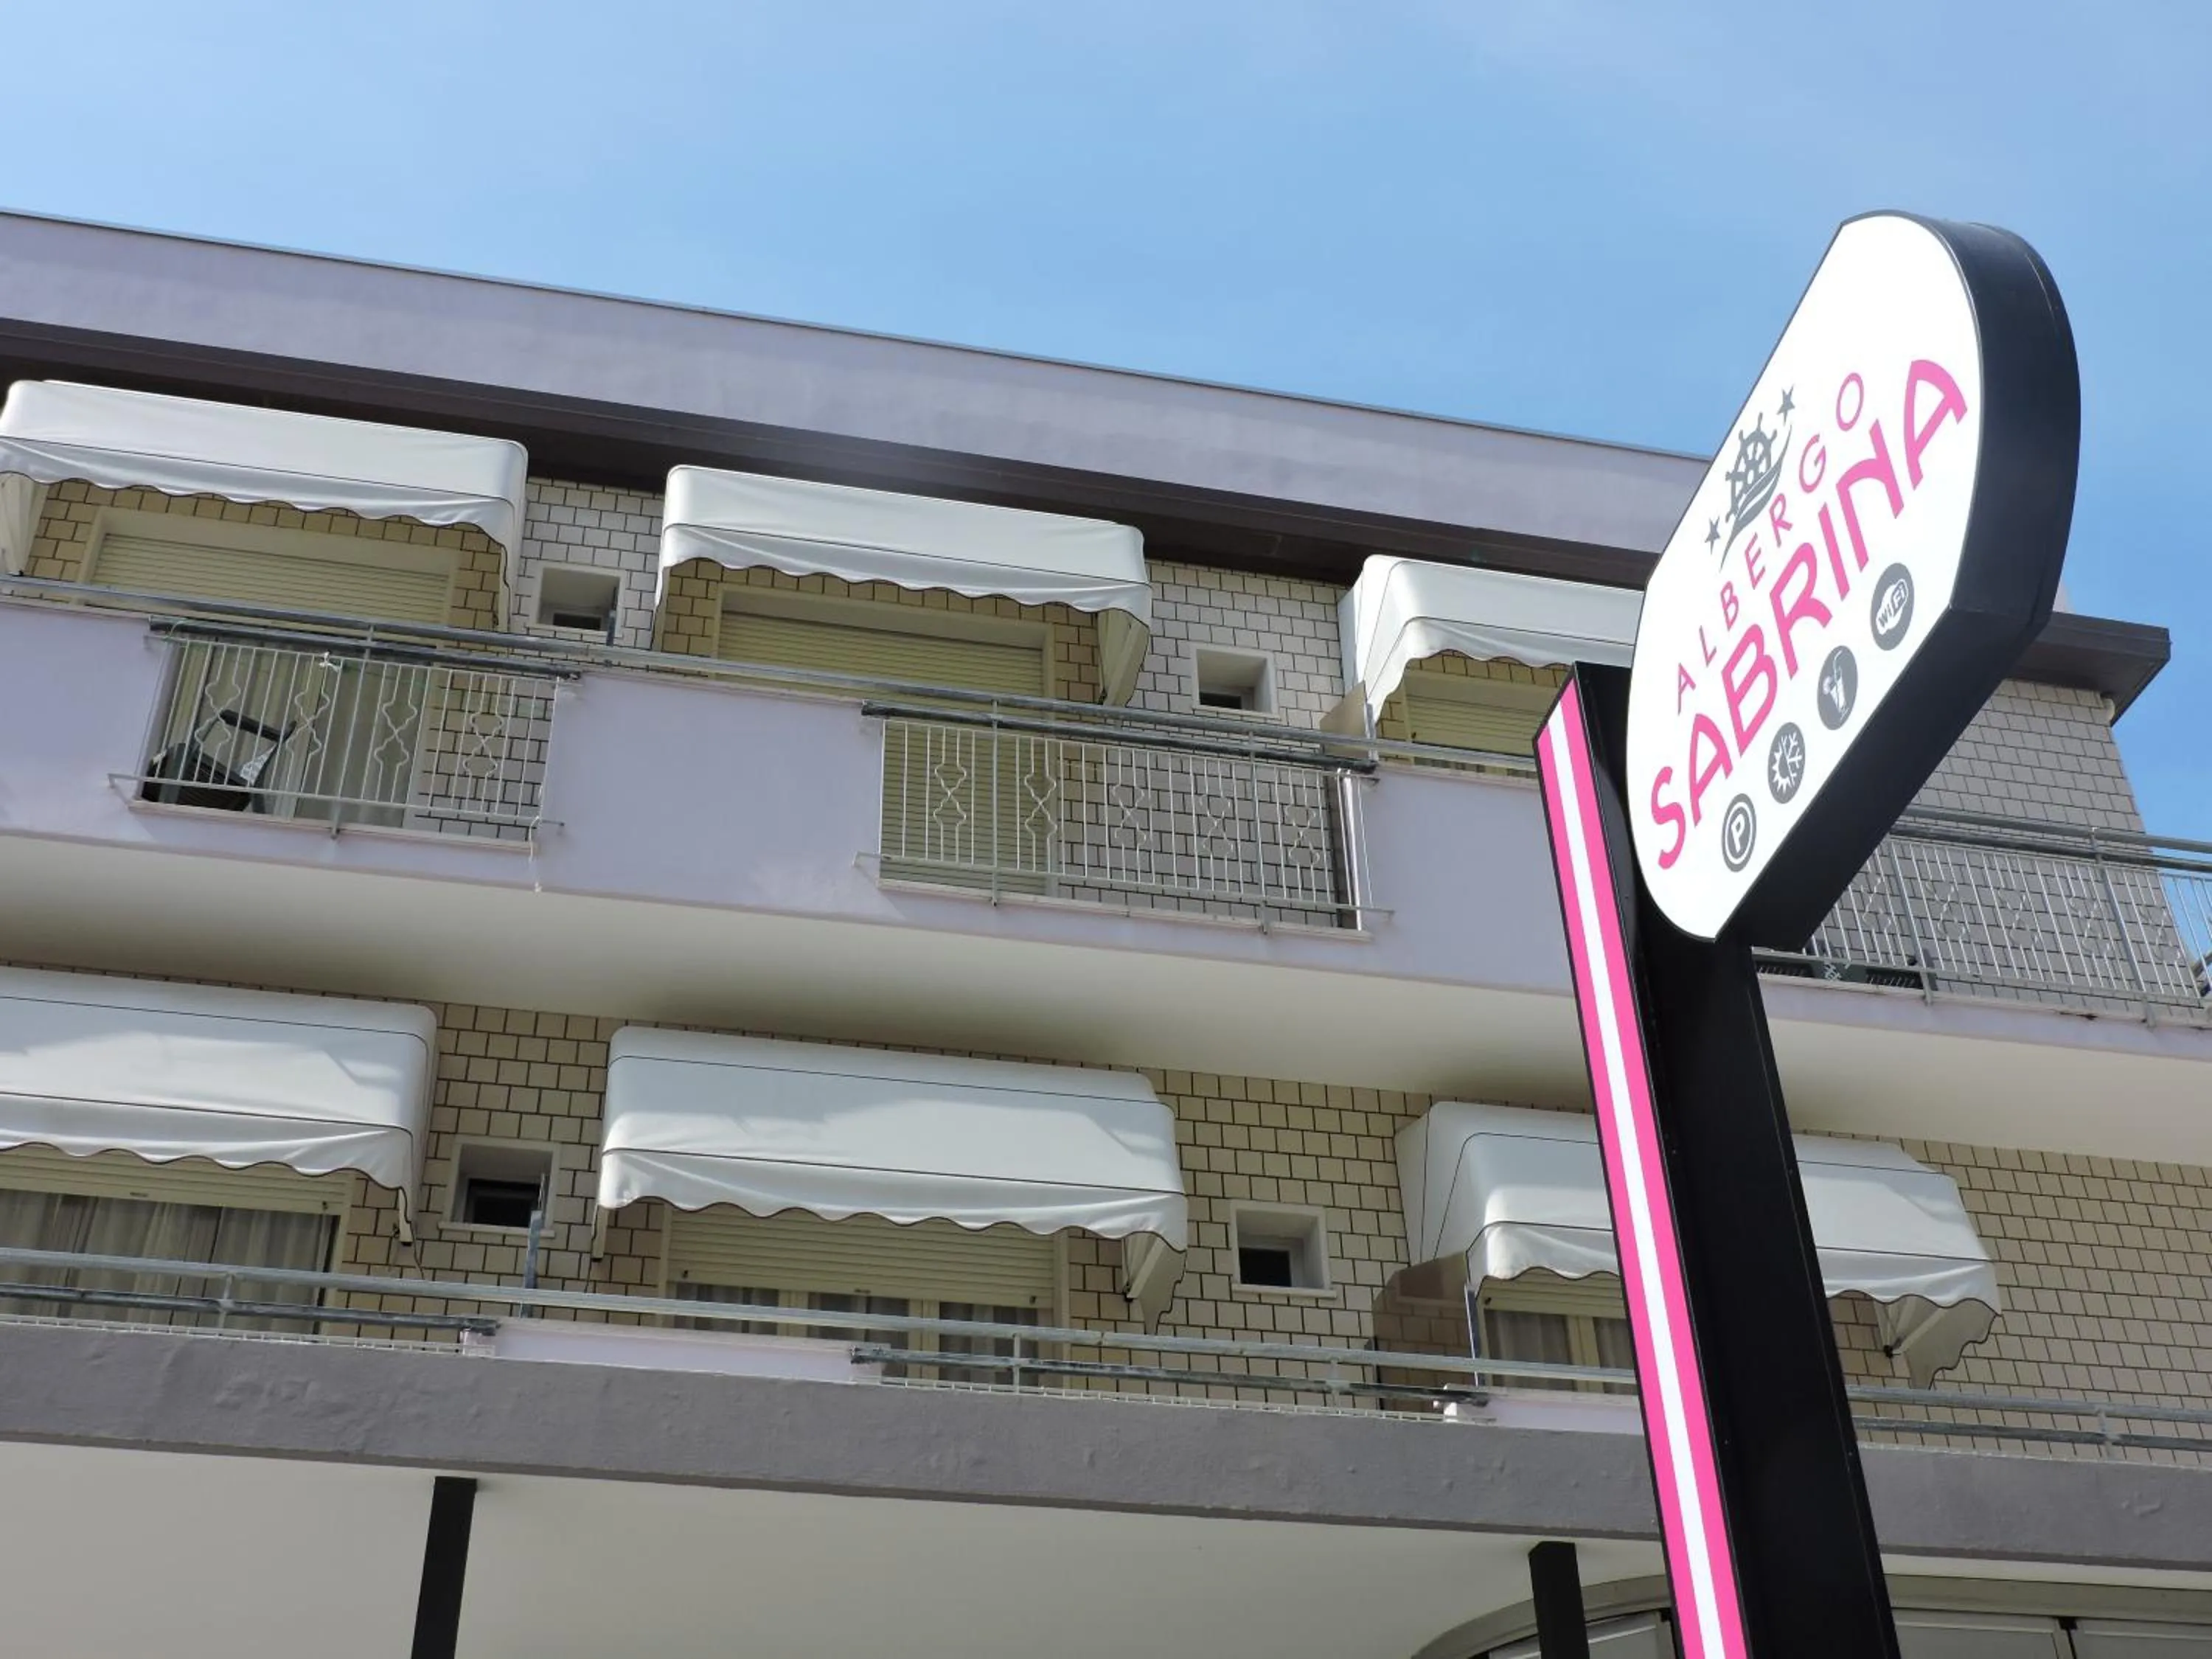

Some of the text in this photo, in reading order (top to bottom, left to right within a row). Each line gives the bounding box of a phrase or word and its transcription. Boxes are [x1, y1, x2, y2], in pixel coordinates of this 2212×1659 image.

[1651, 359, 1967, 869] SABRINA
[1676, 372, 1864, 714] ALBERGO
[1731, 813, 1745, 853] P
